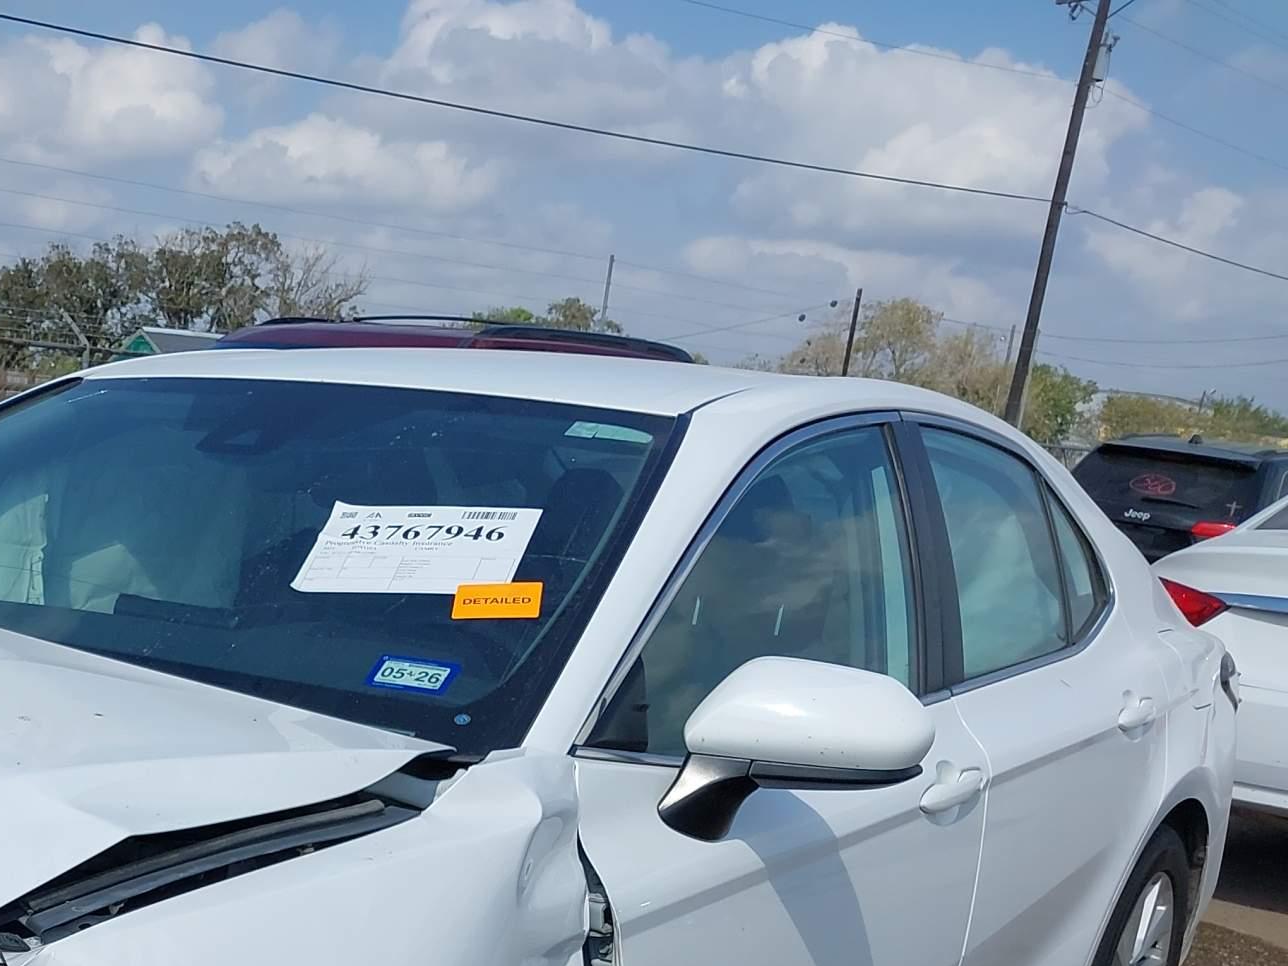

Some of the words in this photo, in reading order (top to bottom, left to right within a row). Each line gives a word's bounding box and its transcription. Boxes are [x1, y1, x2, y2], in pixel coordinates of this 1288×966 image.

[1124, 508, 1151, 521] Jeep
[341, 524, 507, 541] 43767946
[461, 596, 532, 606] DETAILED
[381, 666, 408, 680] 05
[414, 670, 442, 685] 26
